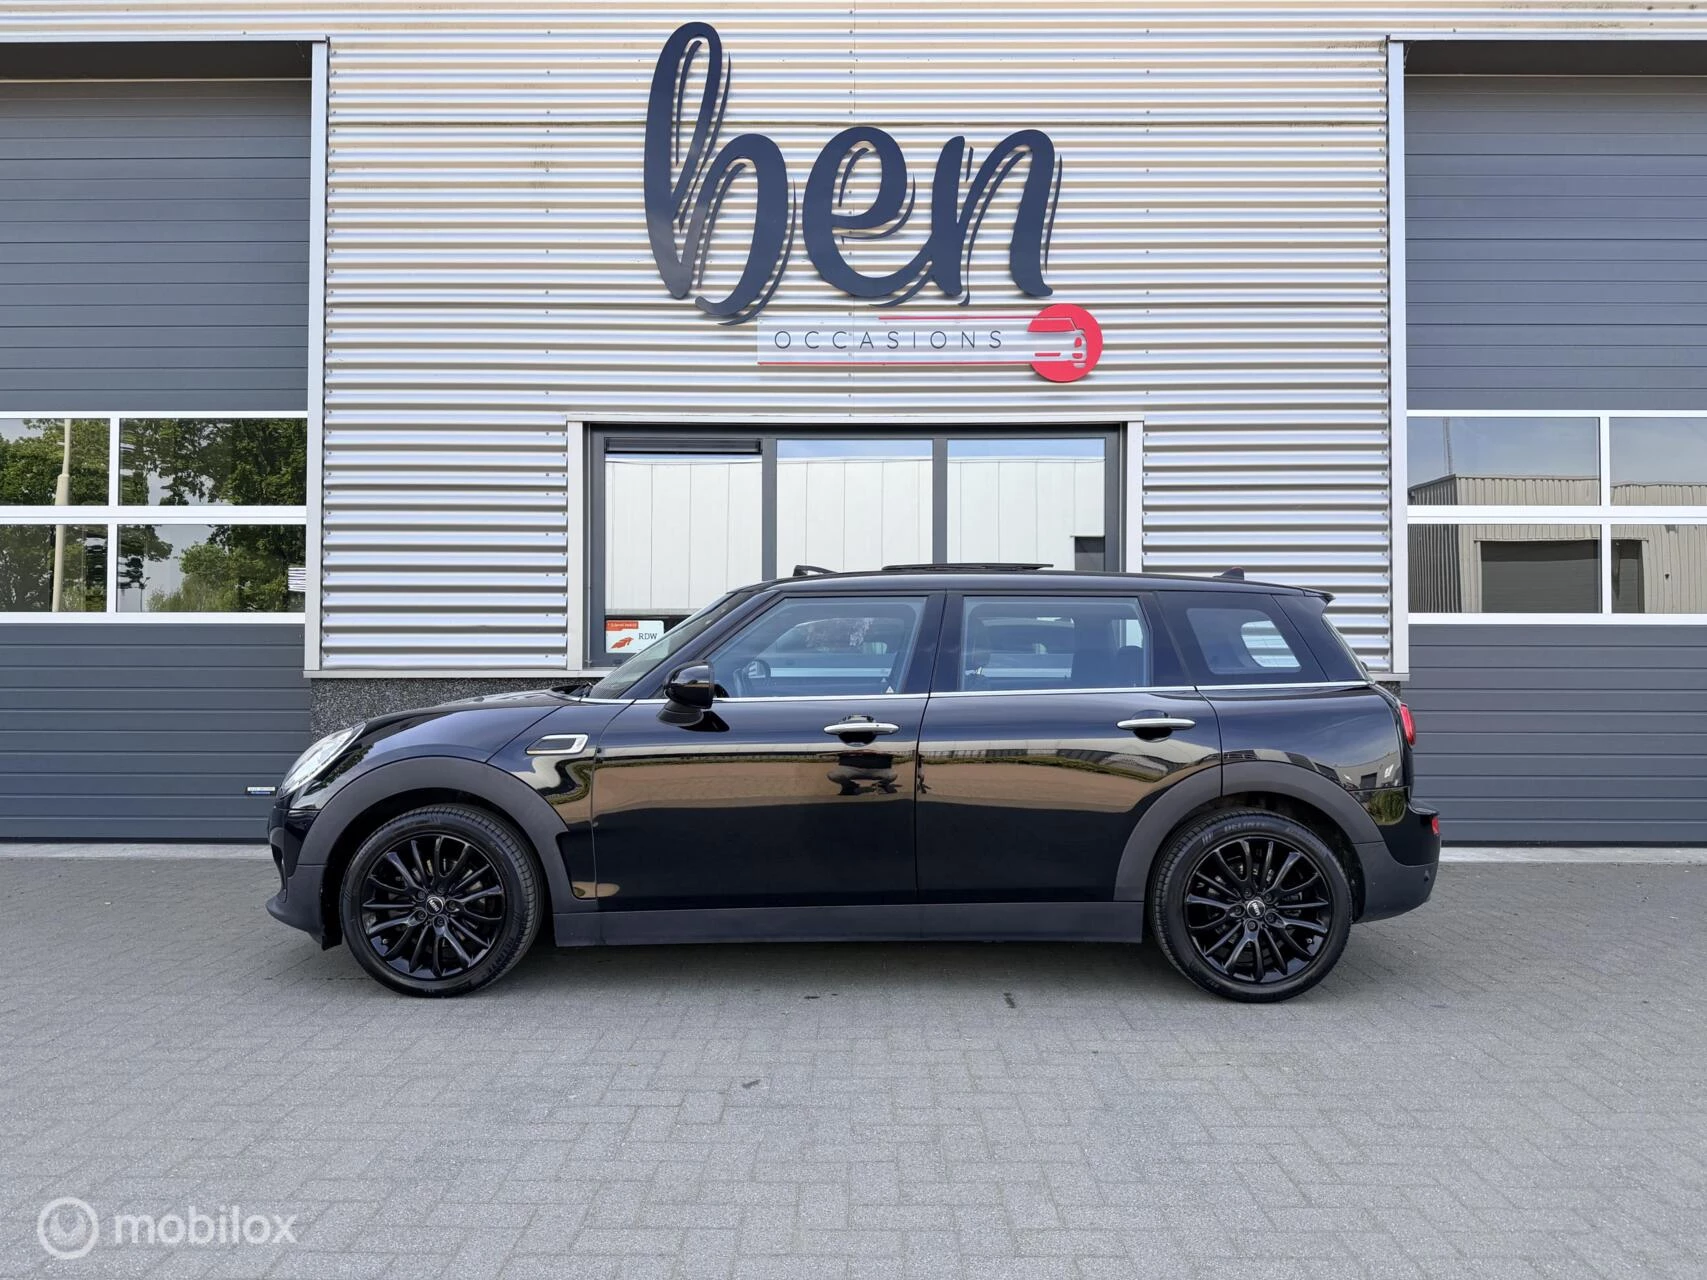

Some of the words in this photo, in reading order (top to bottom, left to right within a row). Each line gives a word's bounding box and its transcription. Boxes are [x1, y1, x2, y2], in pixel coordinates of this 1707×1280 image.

[643, 21, 1062, 324] ben
[773, 329, 1004, 350] OCCASIONS
[638, 632, 658, 640] RDW
